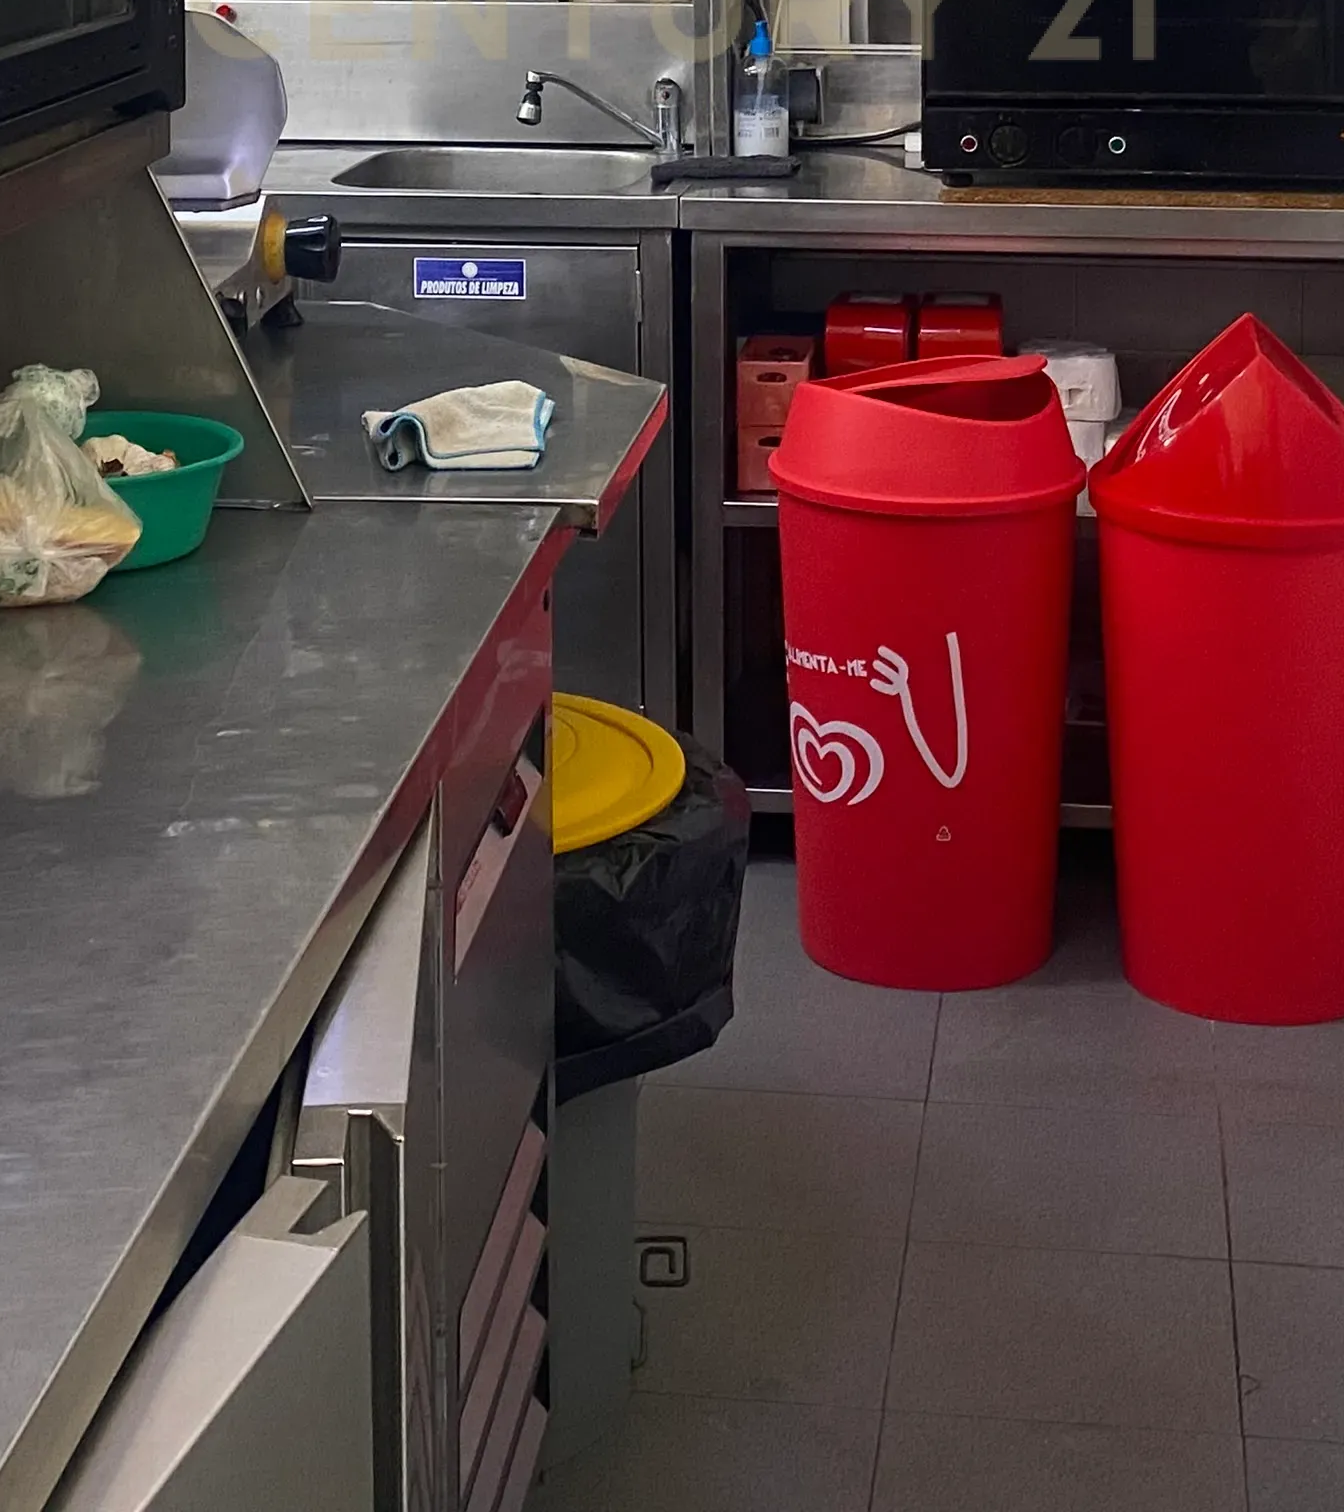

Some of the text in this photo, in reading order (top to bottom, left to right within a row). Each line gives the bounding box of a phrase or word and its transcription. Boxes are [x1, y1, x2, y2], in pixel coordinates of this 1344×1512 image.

[420, 280, 519, 295] PRODUTOS DE LIMPEZA
